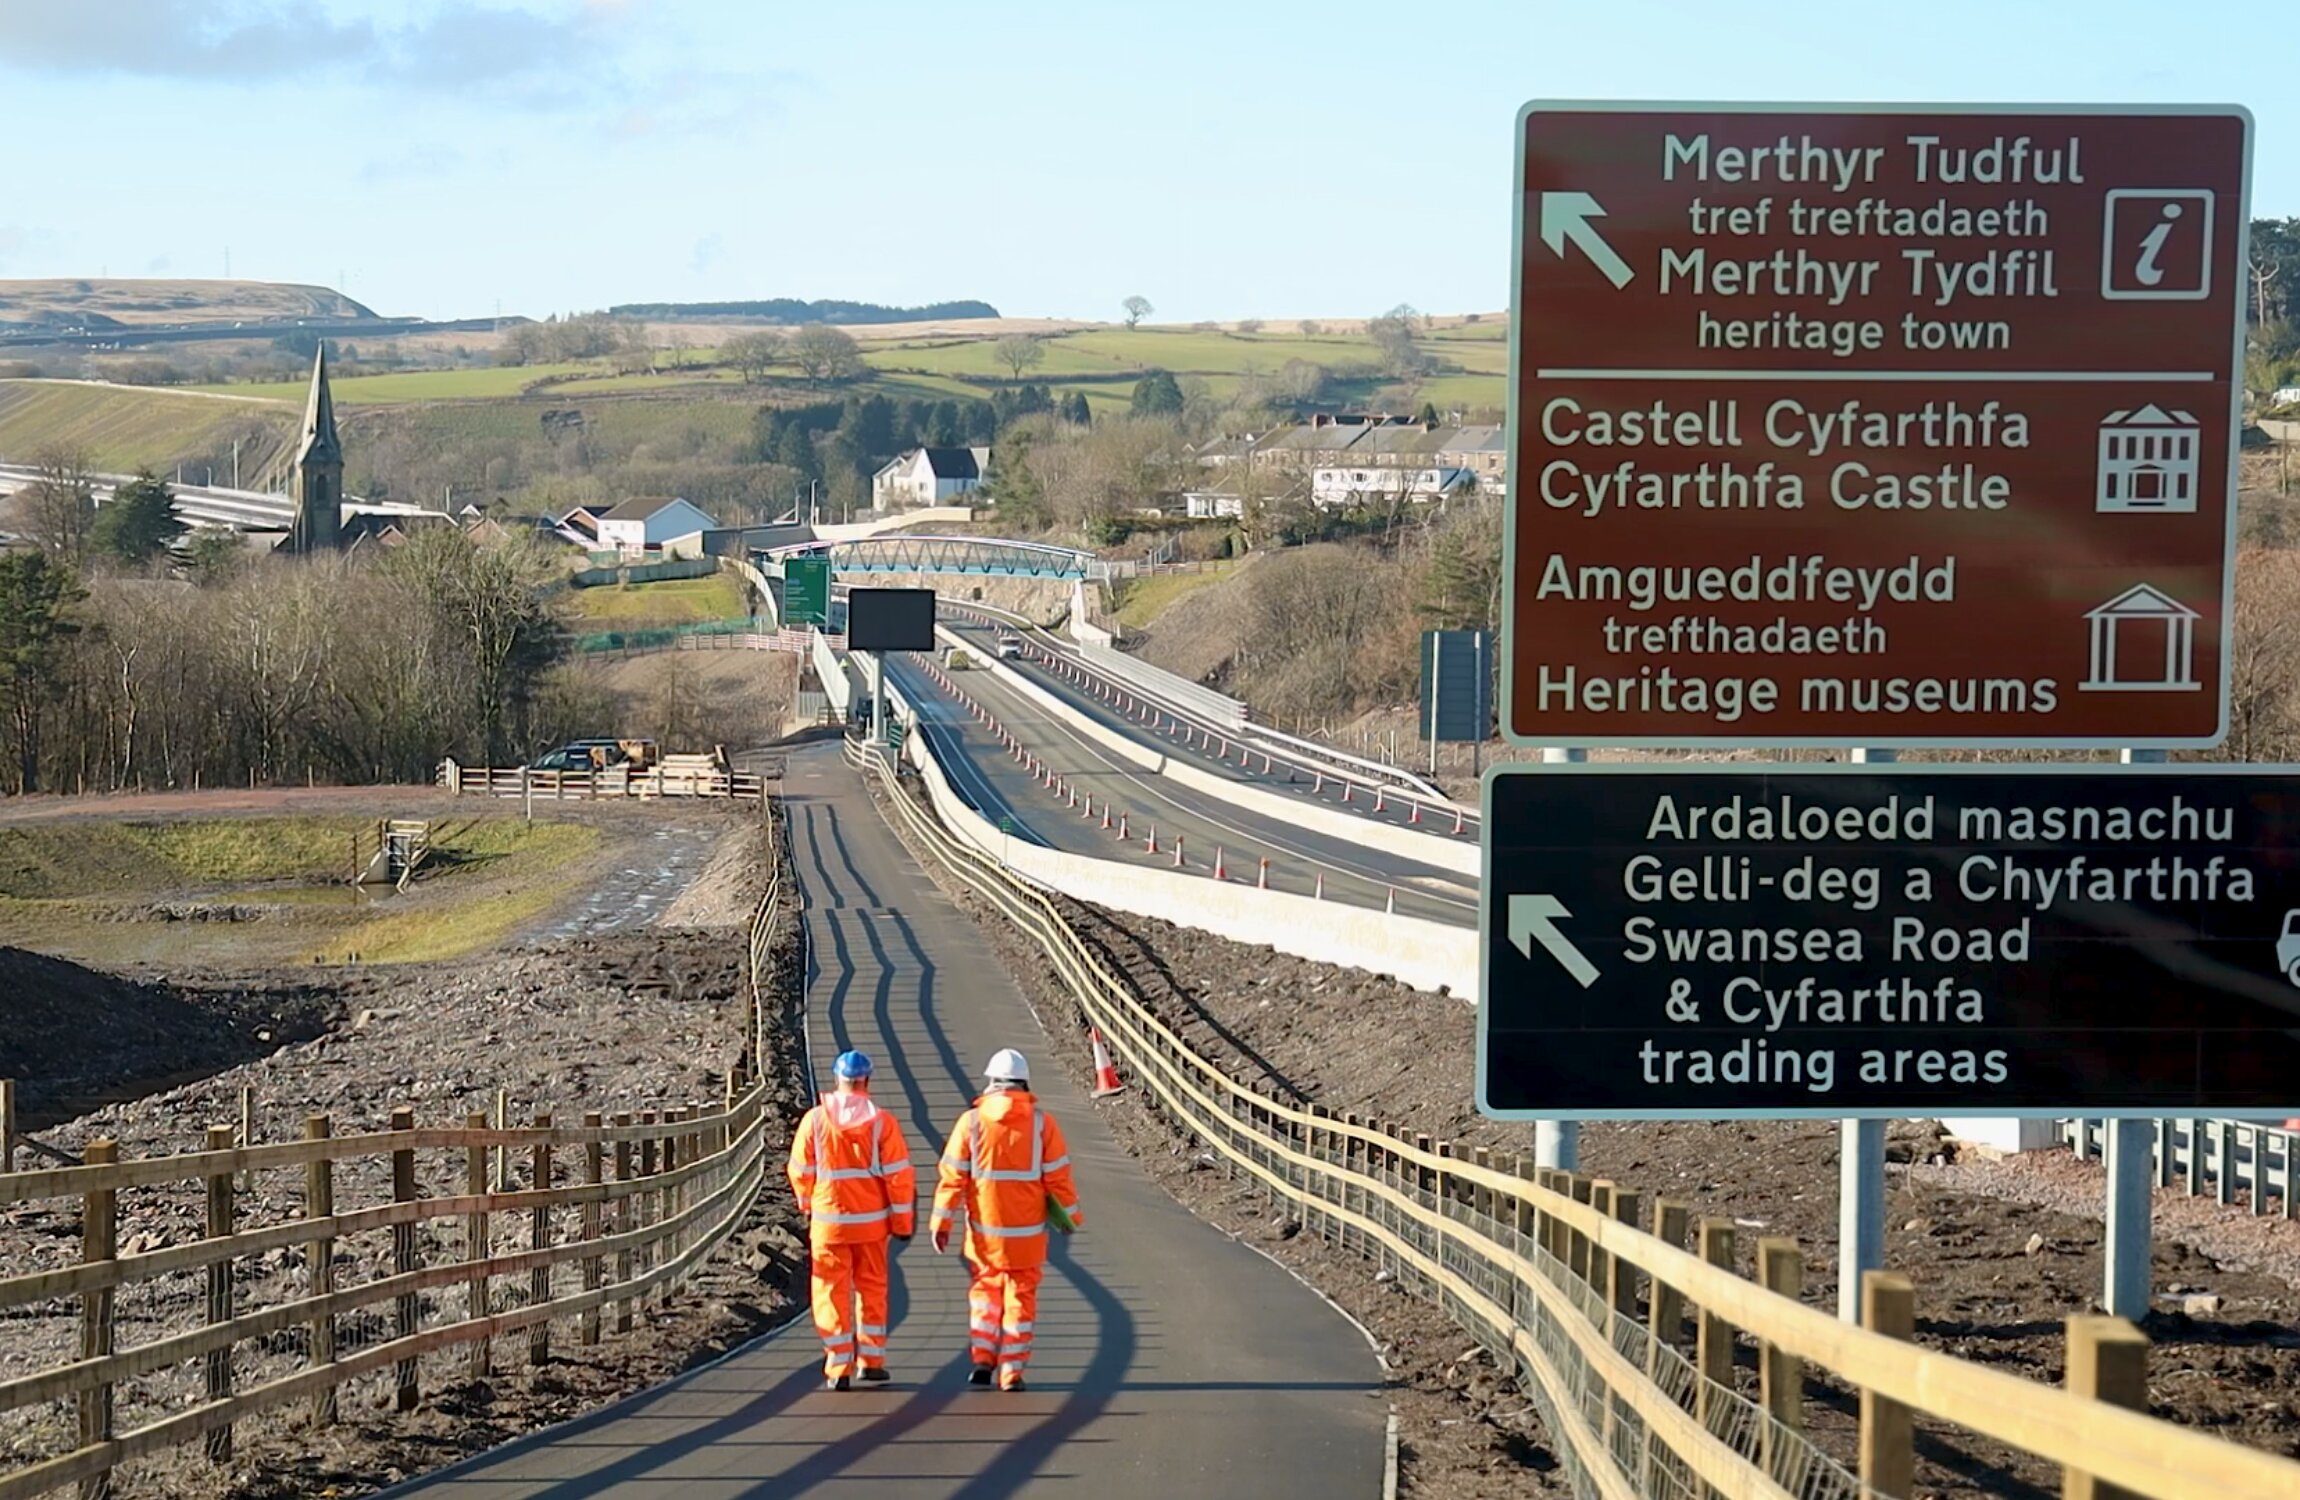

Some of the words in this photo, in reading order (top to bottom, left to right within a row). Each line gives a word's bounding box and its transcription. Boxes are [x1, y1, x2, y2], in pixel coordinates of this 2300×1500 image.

[1663, 134, 1884, 192] Merthyr
[1906, 135, 2084, 184] Tudful
[1688, 197, 1773, 235] tref
[1788, 198, 2047, 237] treftadaeth
[1659, 248, 1880, 306] Merthyr
[1901, 249, 2058, 306] Tydfil
[1698, 310, 1884, 357] heritage
[1901, 312, 2010, 350] town
[1541, 397, 1743, 447] Castell
[1765, 399, 2030, 457] Cyfarthfa
[1540, 460, 1805, 517] Cyfarthfa
[1830, 461, 2010, 510] Castle
[1535, 554, 1955, 611] Amgueddfeydd
[1602, 615, 1886, 654] trefthadaeth
[1538, 665, 1778, 722] Heritage
[1801, 678, 2057, 713] museums
[1646, 795, 1934, 841] Ardaloedd
[1959, 795, 2234, 841] masnachu
[1624, 854, 1880, 911] Gelli-deg
[1904, 867, 1933, 902] a
[1959, 854, 2255, 911] Chyfarthfa
[1623, 916, 1864, 963] Swansea
[1892, 916, 2030, 962] Road
[1665, 977, 1700, 1023] &
[1723, 976, 1984, 1032] Cyfarthfa
[1638, 1038, 1835, 1093] trading
[1859, 1049, 2008, 1084] areas
